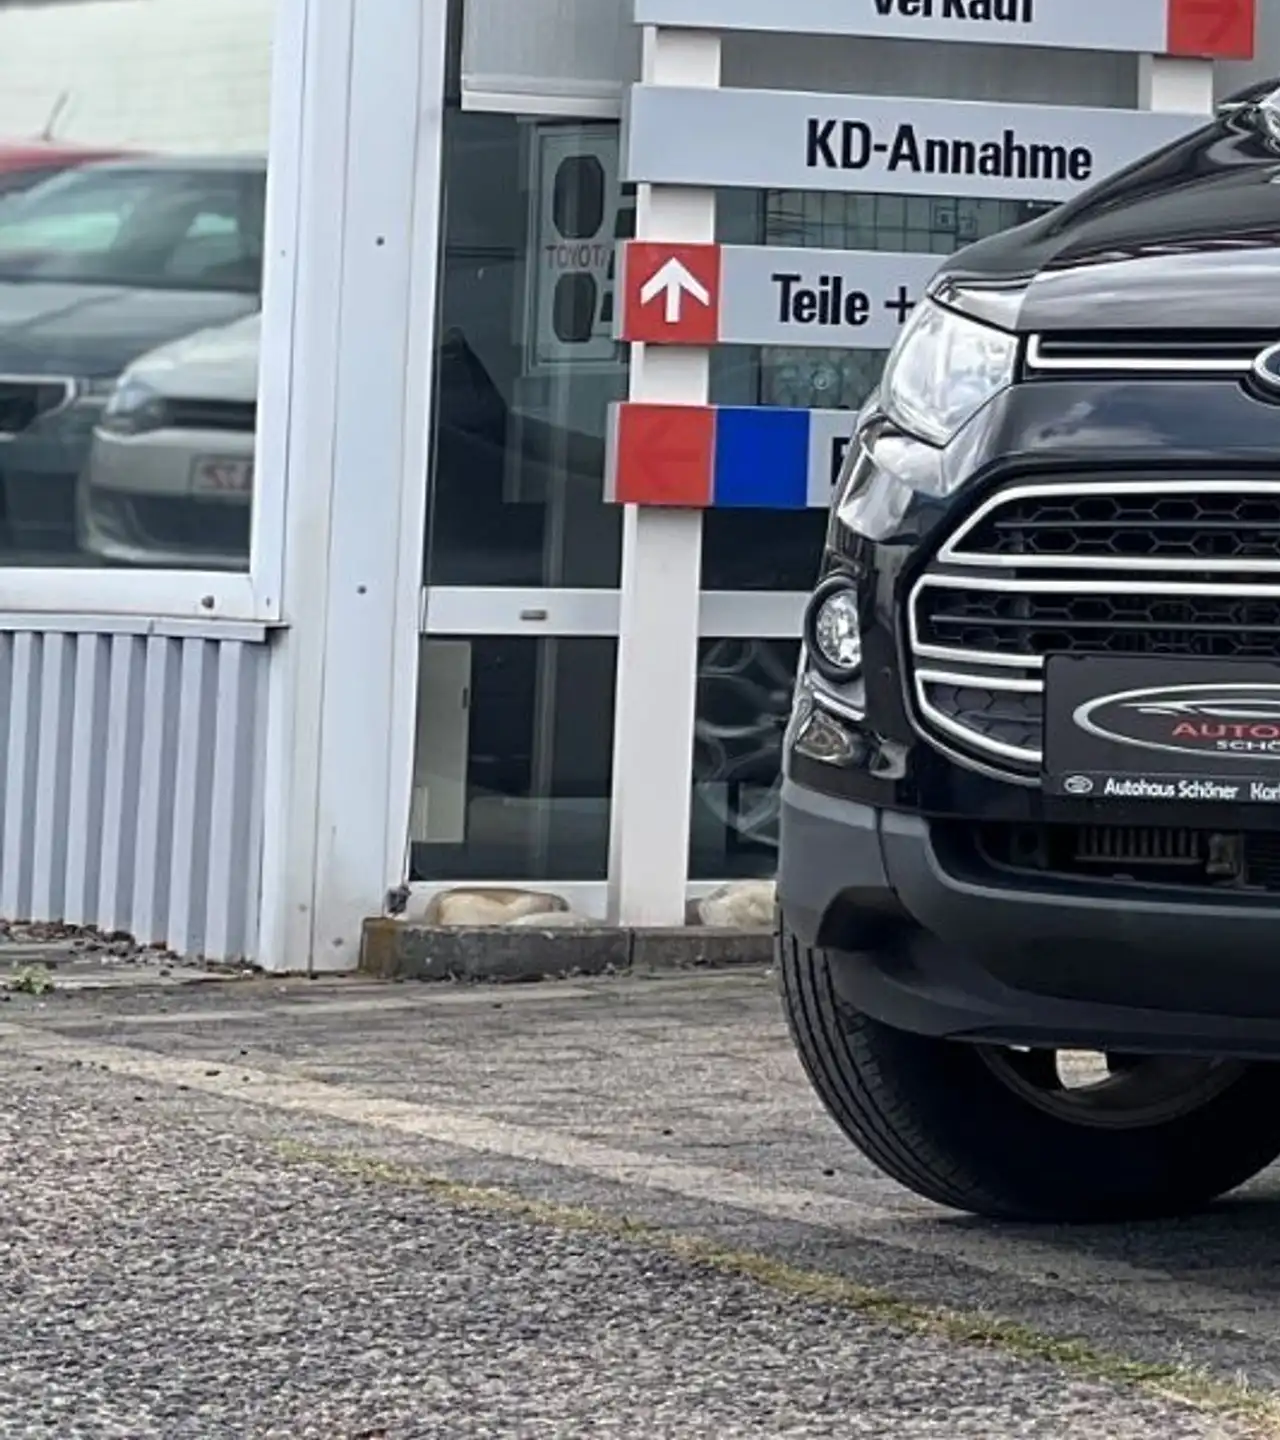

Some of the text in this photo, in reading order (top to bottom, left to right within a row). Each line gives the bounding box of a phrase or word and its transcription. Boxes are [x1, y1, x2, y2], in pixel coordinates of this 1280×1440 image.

[806, 118, 1092, 180] KD-Annahme
[771, 273, 917, 326] Teile +
[1104, 777, 1175, 796] Autohaus
[1178, 780, 1239, 799] Schöner
